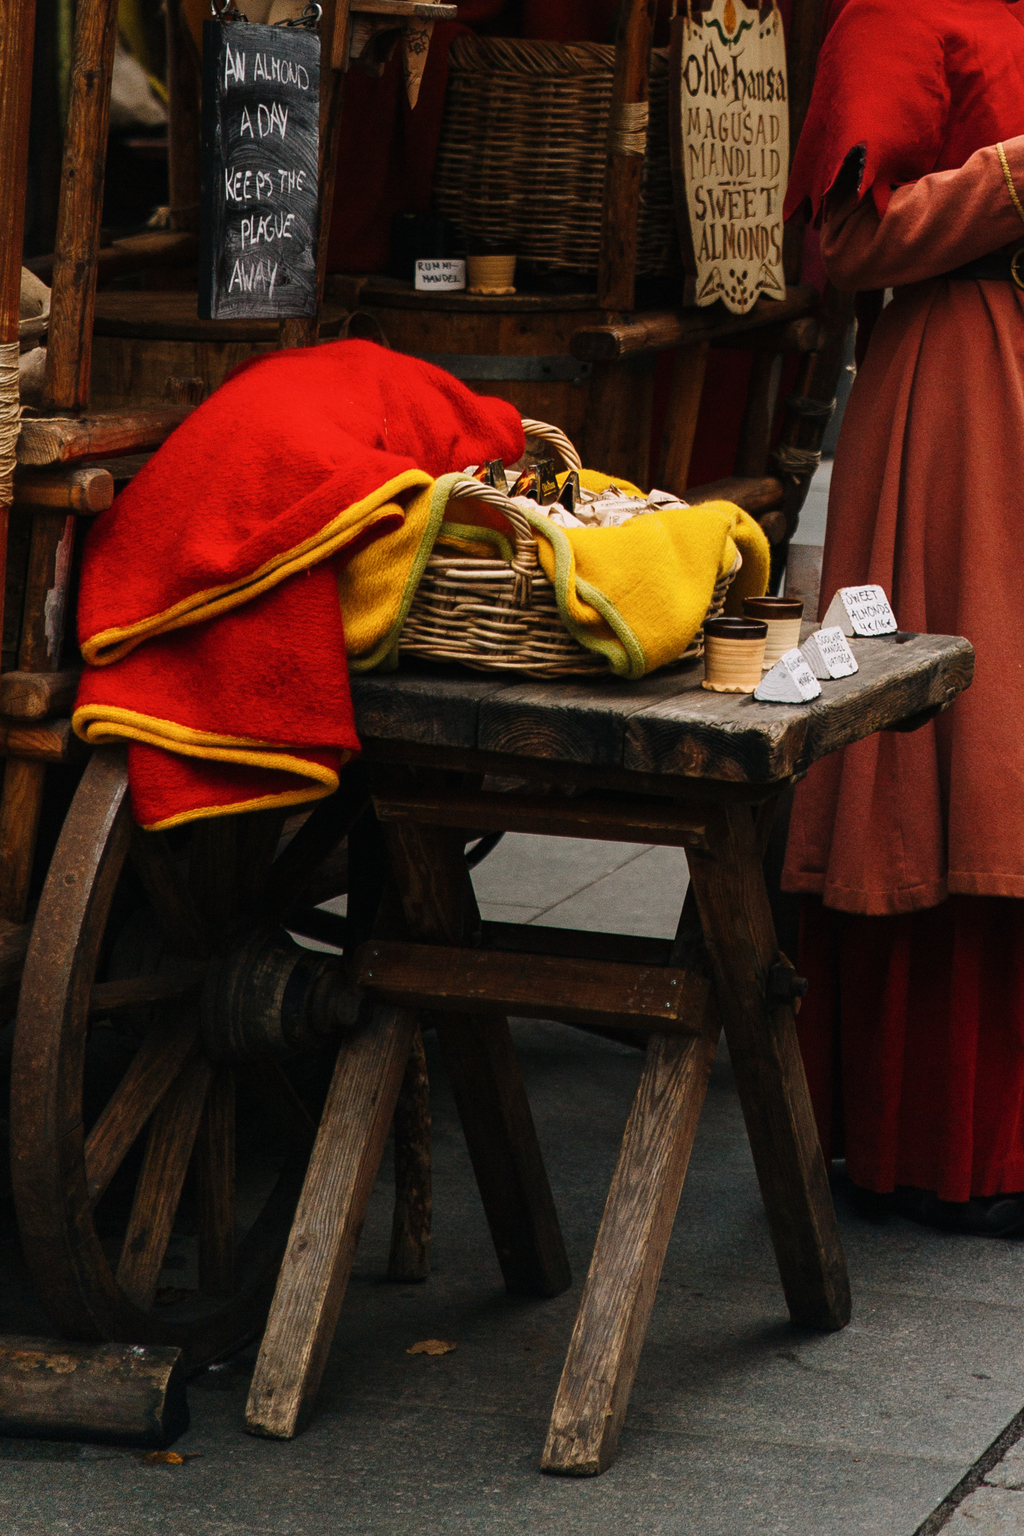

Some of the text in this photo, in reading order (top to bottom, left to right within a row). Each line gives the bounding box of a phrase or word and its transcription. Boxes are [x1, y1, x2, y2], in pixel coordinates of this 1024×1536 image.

[224, 42, 310, 91] AN ALMOND
[682, 39, 728, 98] Olde
[240, 101, 289, 140] A DAY
[687, 107, 780, 145] MAGUSAD
[688, 143, 780, 182] MANDLID
[225, 166, 307, 201] KEEPS THE
[695, 183, 779, 222] SWEET
[240, 212, 296, 251] PLAGUE
[697, 222, 782, 267] ALMONDS
[228, 259, 278, 299] AWAY
[845, 590, 878, 605] SWEET
[851, 603, 891, 622] ALMONDS
